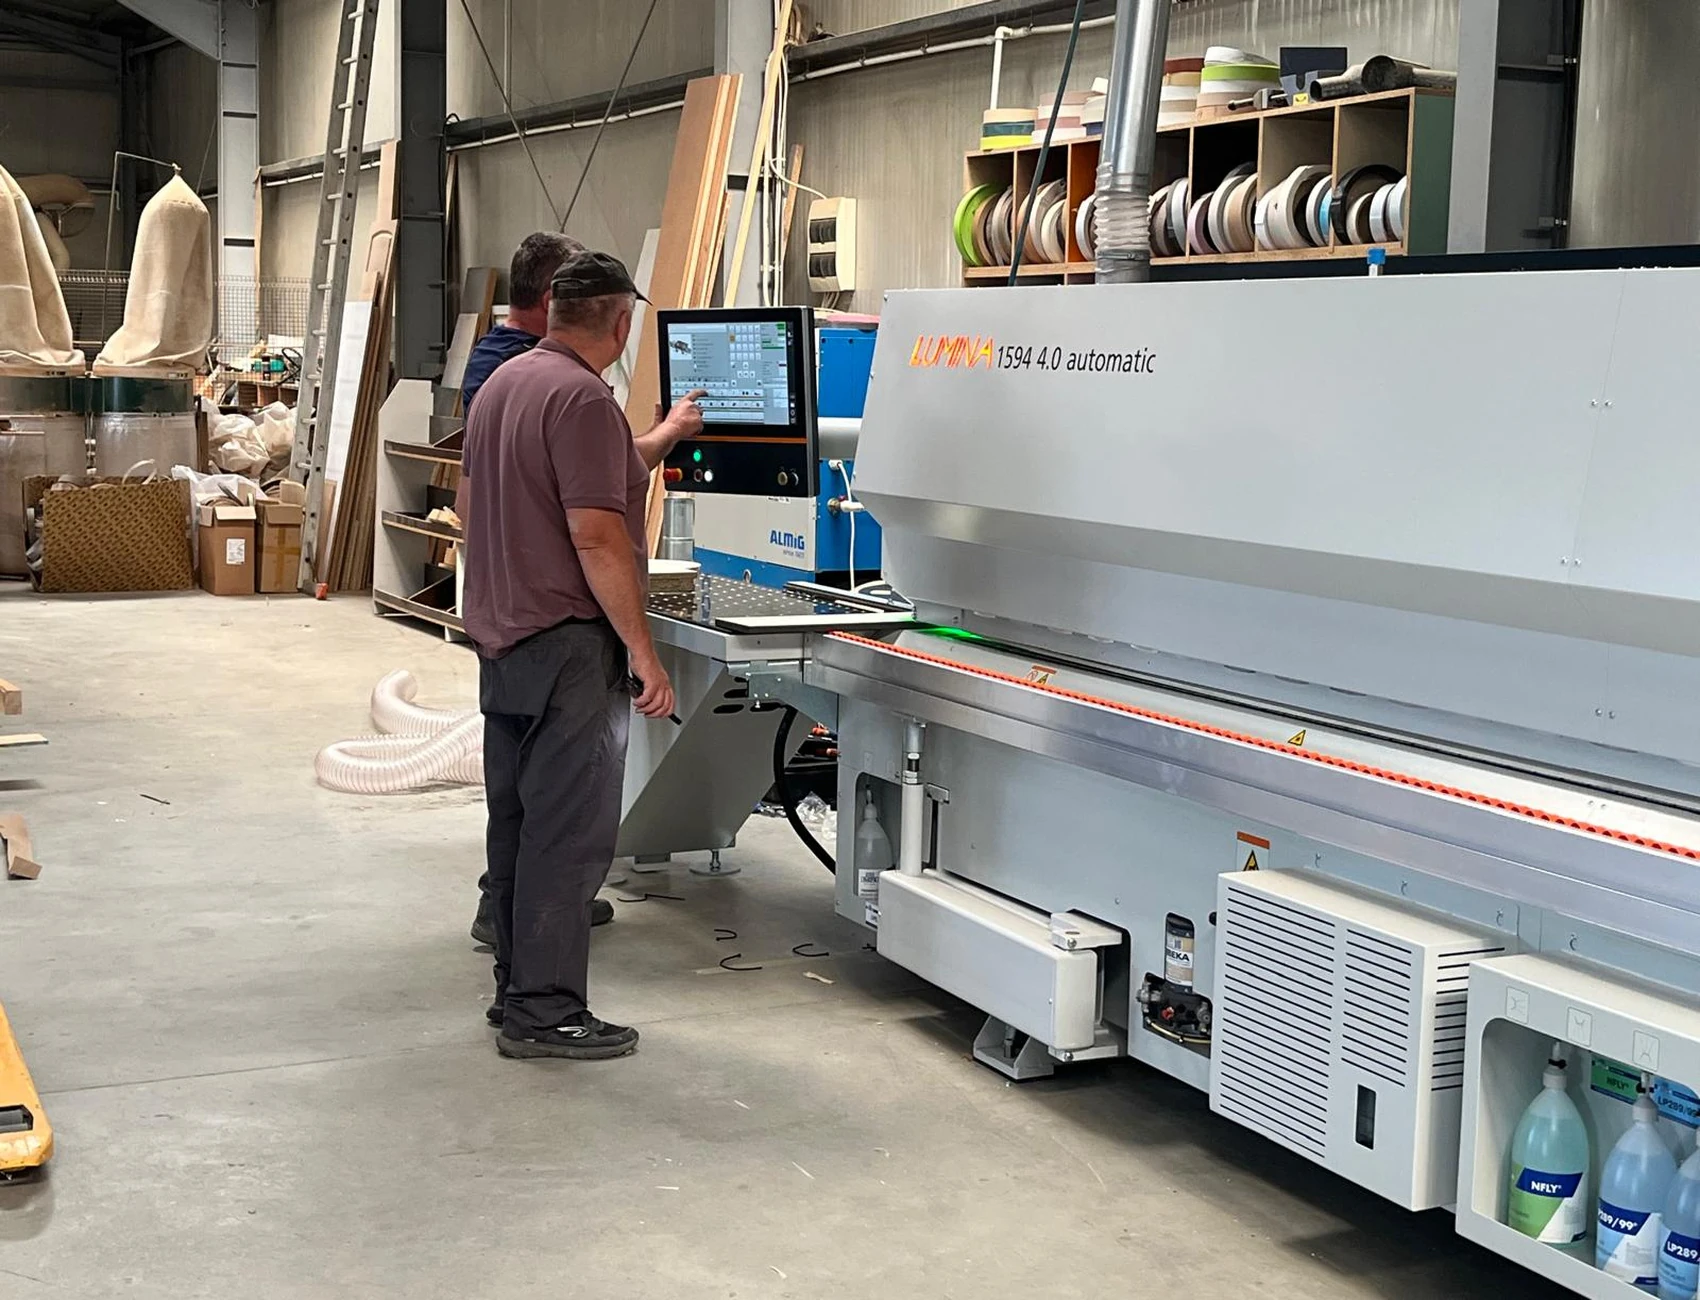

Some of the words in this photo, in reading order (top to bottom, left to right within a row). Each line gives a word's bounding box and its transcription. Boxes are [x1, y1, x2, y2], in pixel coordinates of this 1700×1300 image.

[909, 334, 995, 369] LUMINA
[997, 346, 1032, 370] 1594
[1036, 346, 1062, 371] 4.0
[1066, 347, 1157, 374] automatic
